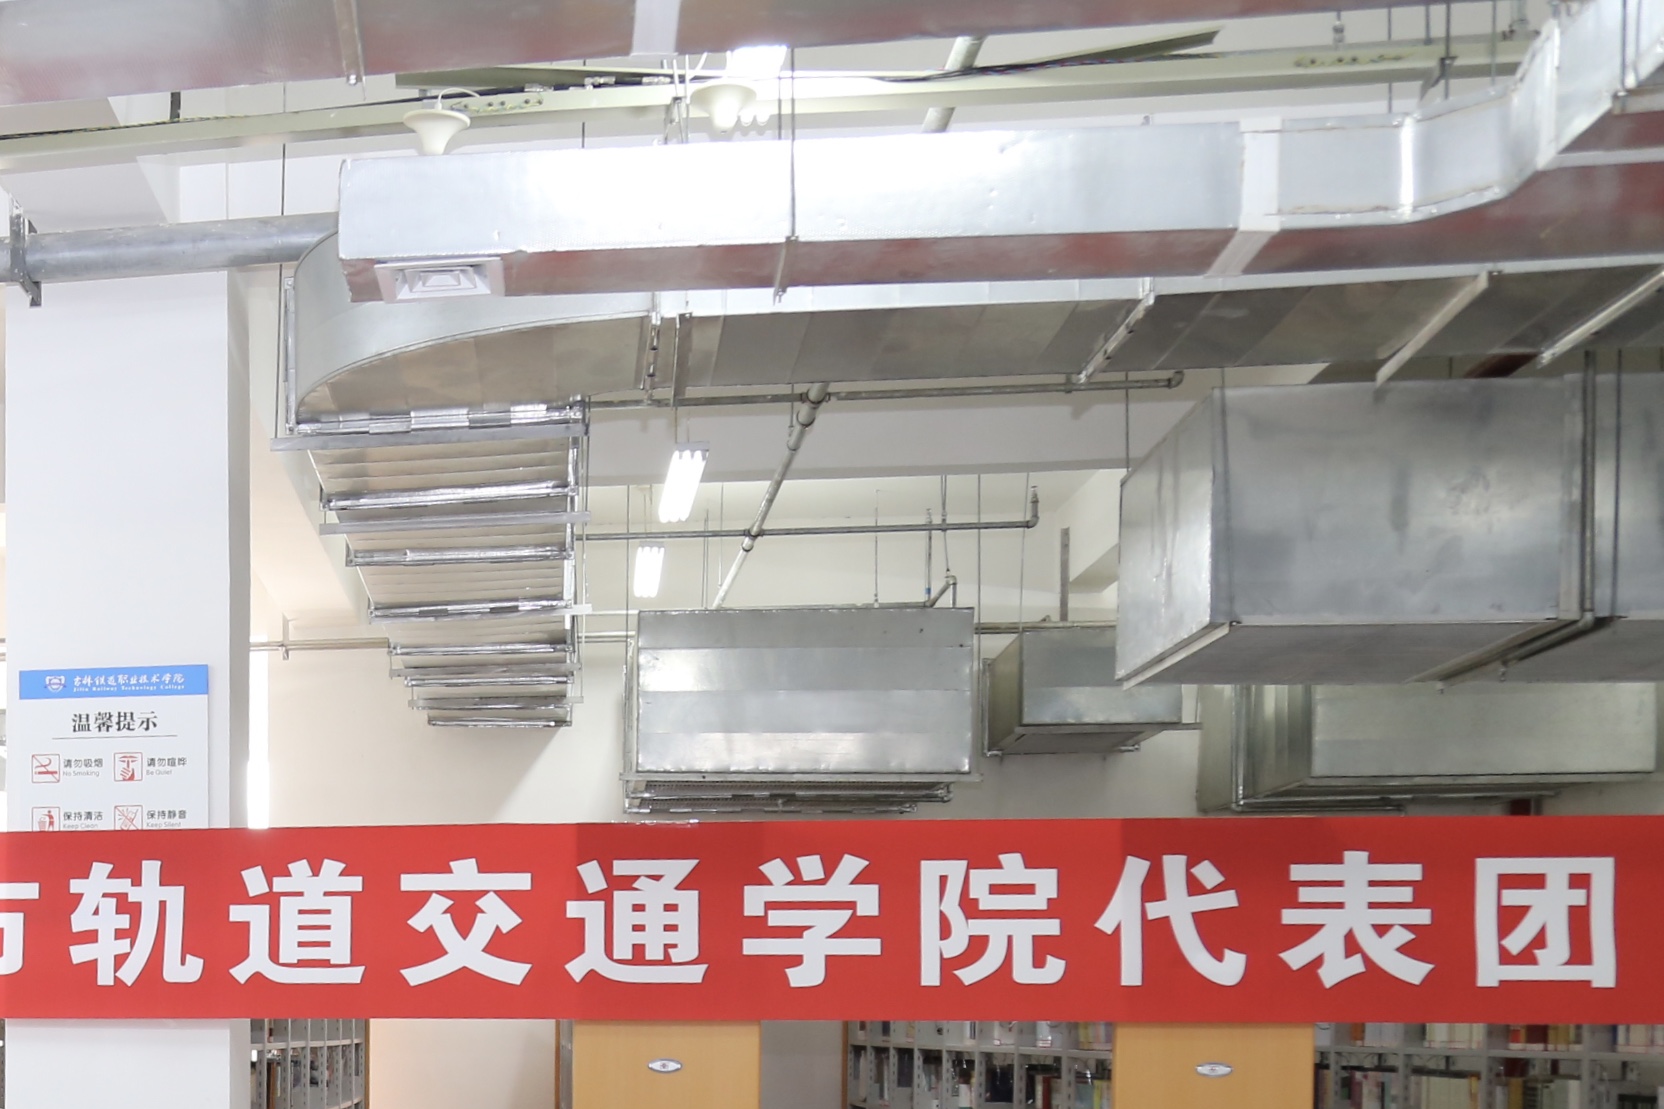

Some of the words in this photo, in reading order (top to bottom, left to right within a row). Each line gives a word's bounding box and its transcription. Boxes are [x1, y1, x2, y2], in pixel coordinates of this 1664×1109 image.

[71, 710, 158, 733] 温馨提示
[63, 758, 104, 769] 请勿吸烟
[147, 756, 188, 768] 请勿喧哗
[63, 811, 104, 822] 保持清洁
[146, 810, 187, 820] 保持静音
